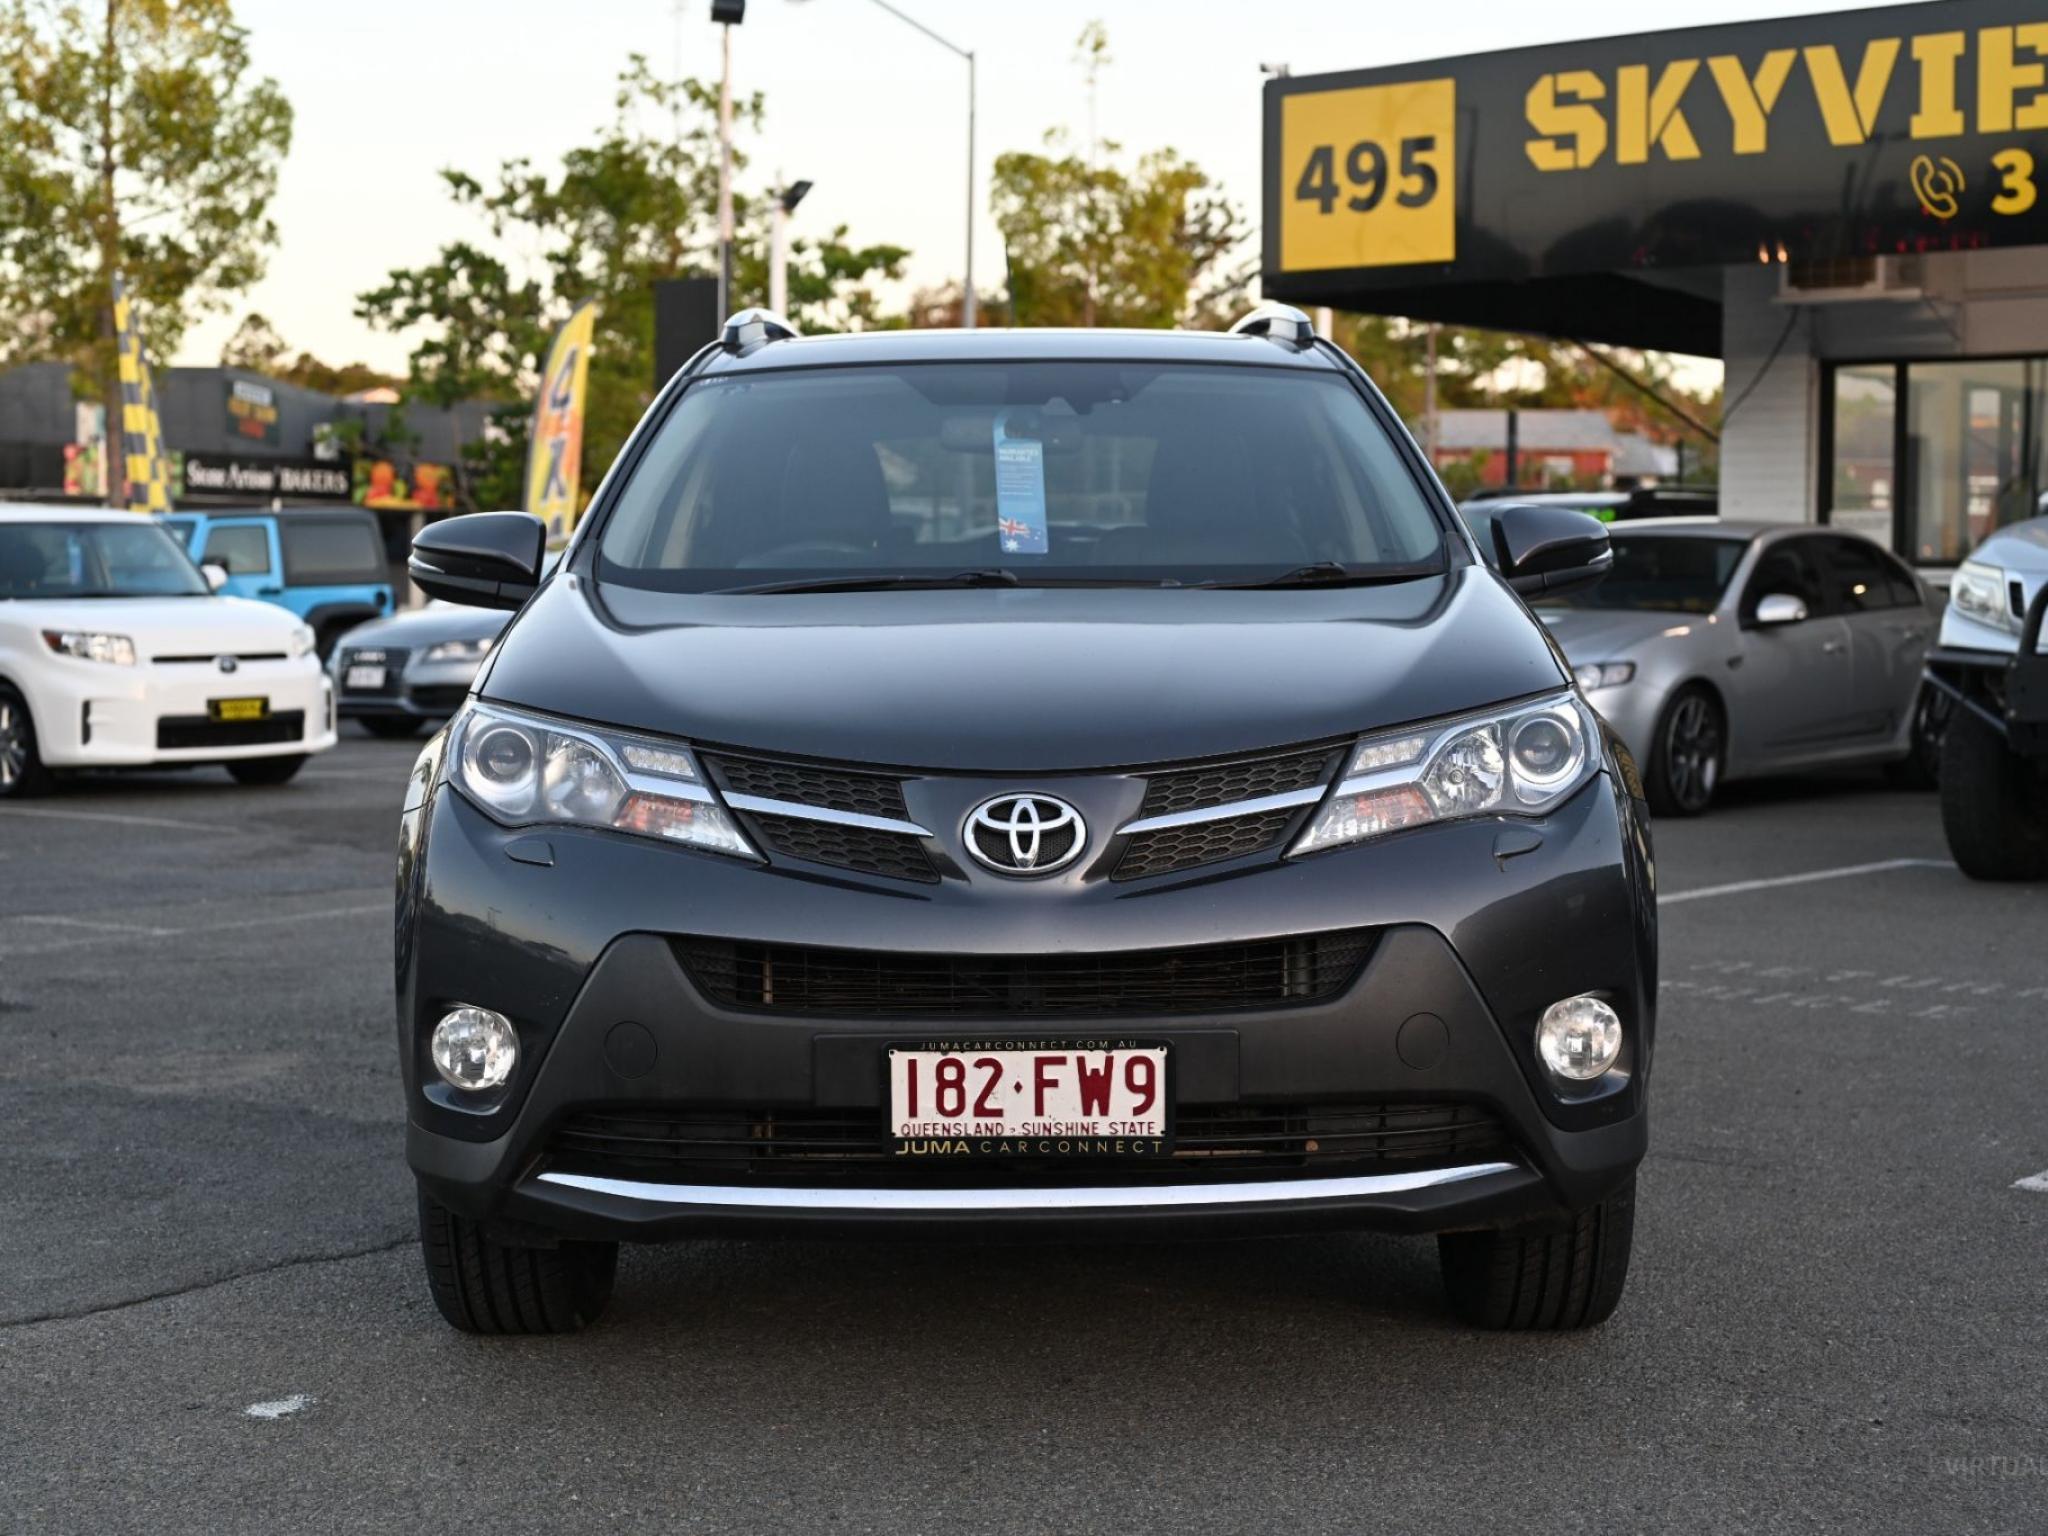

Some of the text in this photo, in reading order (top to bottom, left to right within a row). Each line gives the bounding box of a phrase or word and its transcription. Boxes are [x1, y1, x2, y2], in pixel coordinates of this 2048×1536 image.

[1525, 22, 2048, 172] SKYVIE
[1295, 135, 1439, 216] 495
[1990, 148, 2038, 216] 3
[895, 1141, 970, 1155] JUMA
[900, 1121, 1156, 1136] QUEENSLAND SUNSHINE STATE
